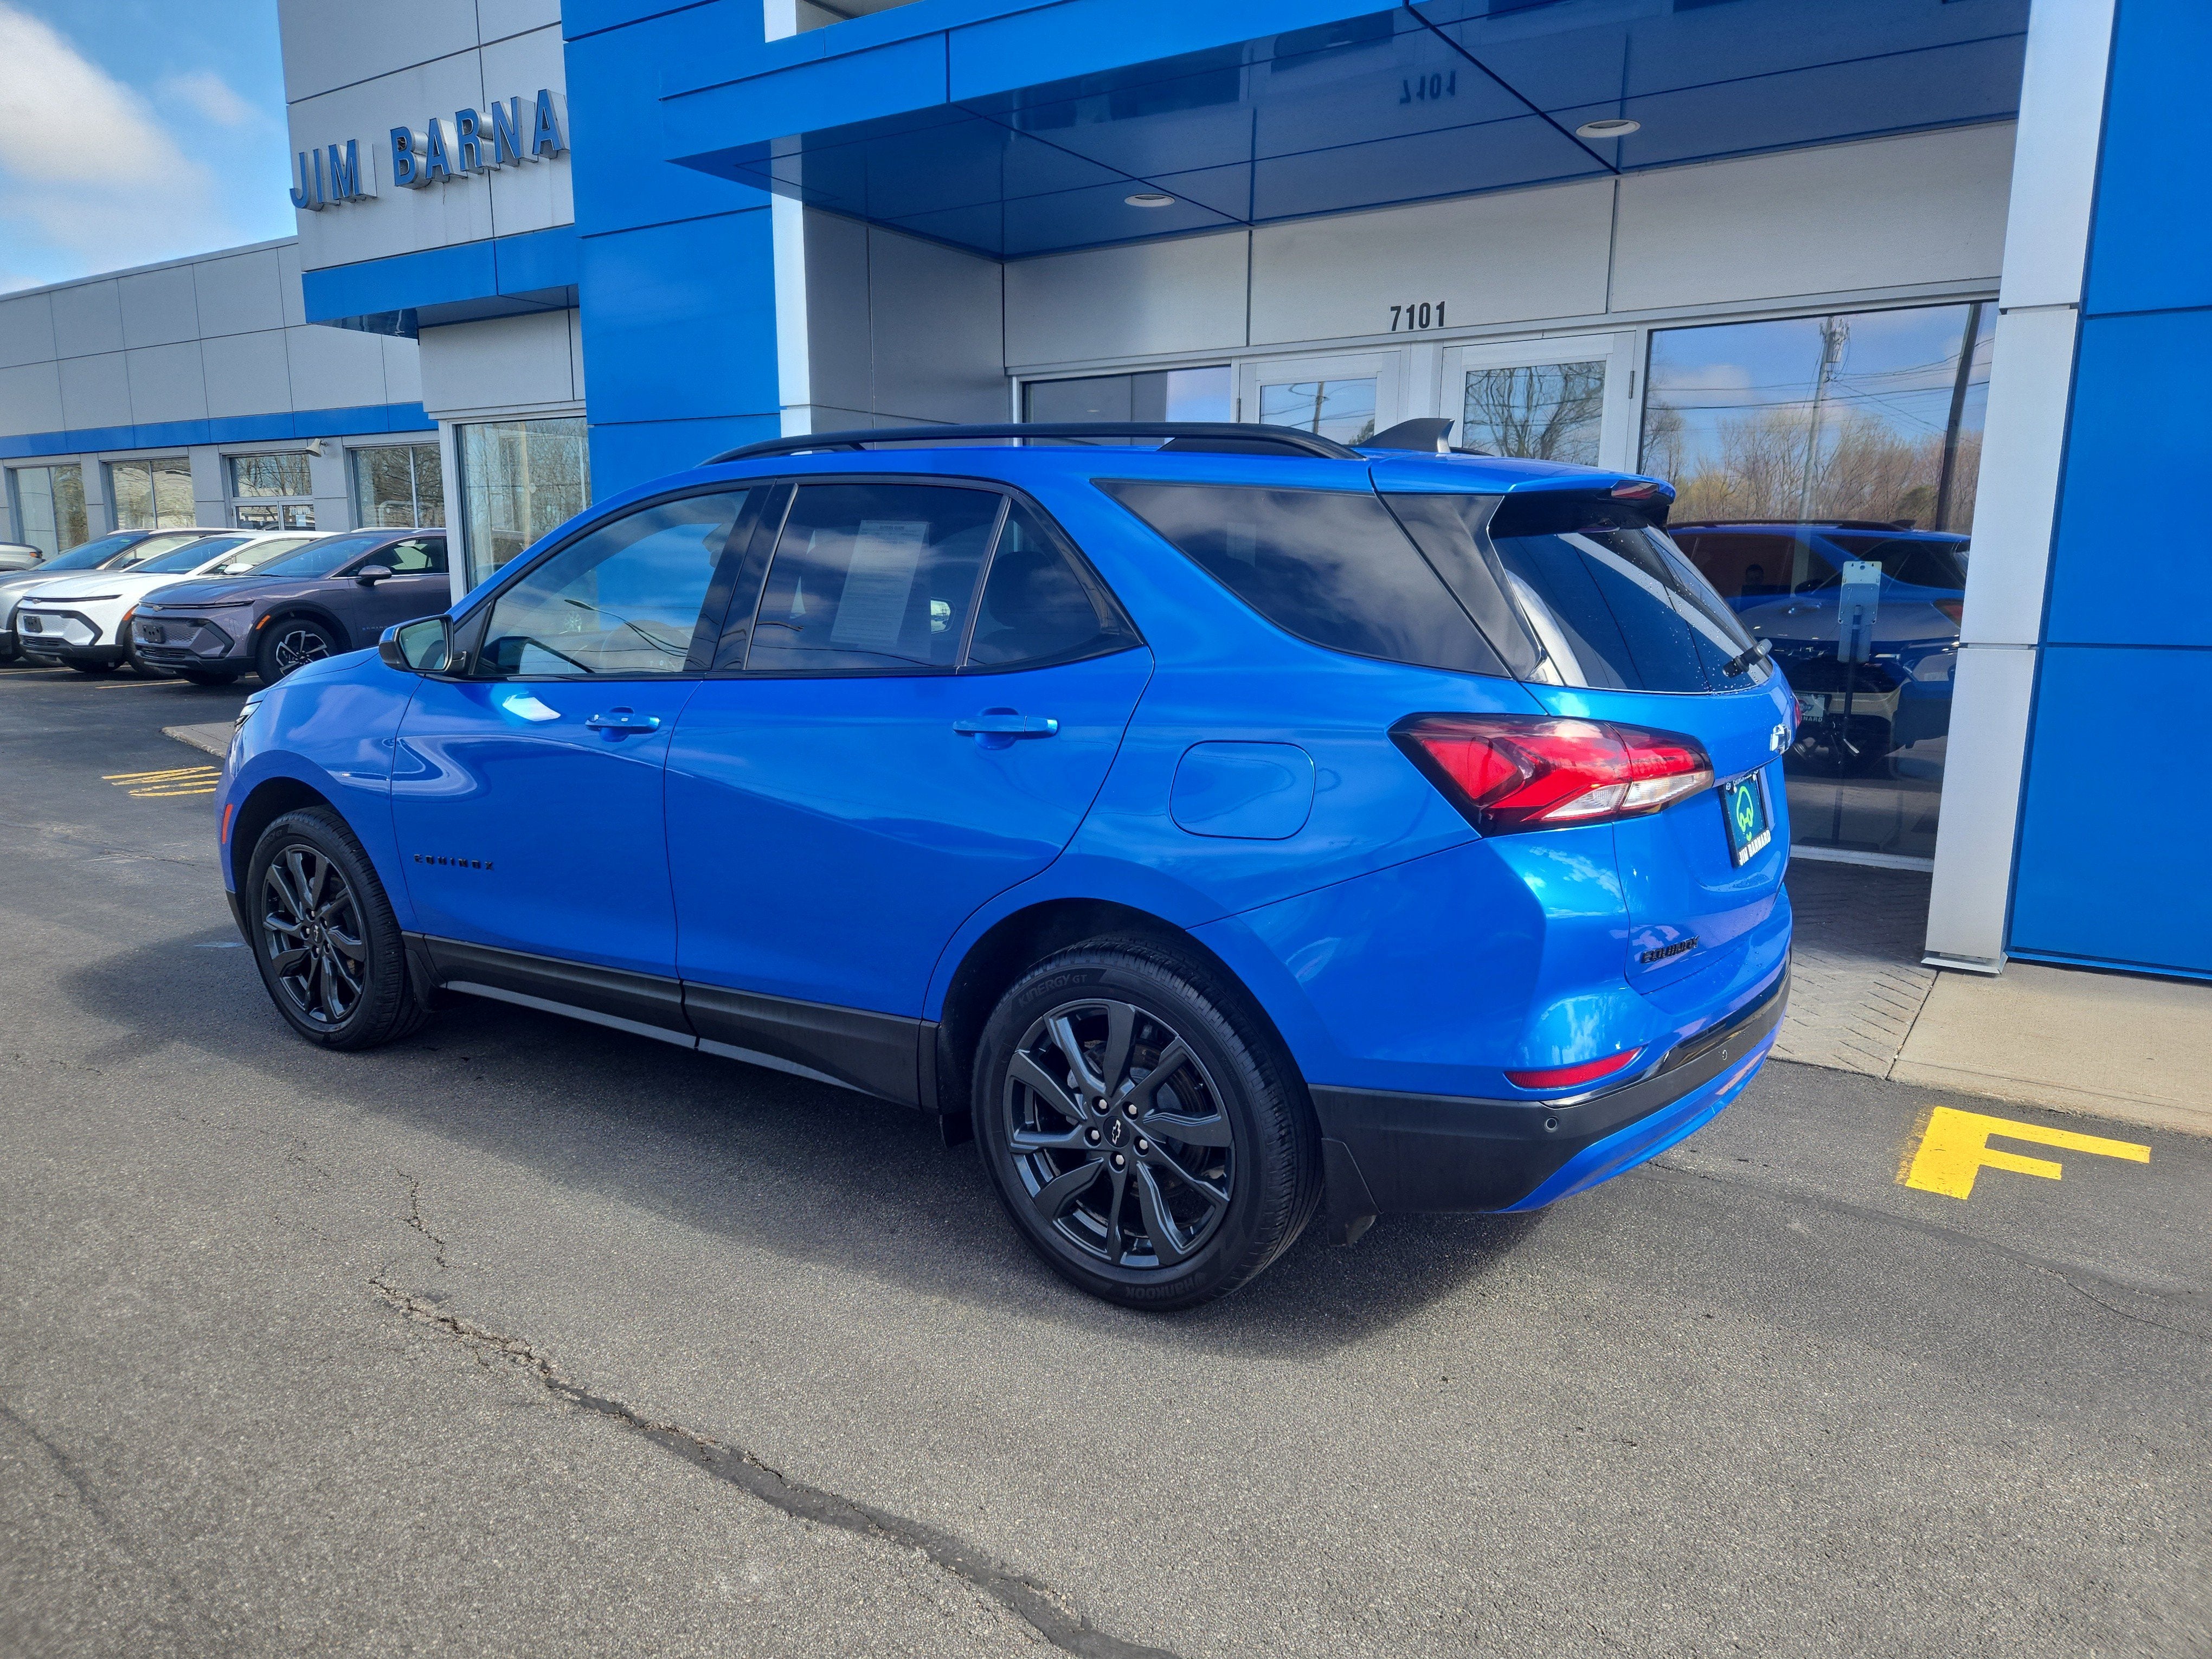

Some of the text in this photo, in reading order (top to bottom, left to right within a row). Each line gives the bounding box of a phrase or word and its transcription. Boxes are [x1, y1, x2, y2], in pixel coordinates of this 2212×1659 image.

[290, 89, 566, 210] JIM BARNA
[1390, 301, 1445, 331] 7101
[414, 854, 494, 870] EQUINOX
[1739, 829, 1771, 866] JIM BARNARD
[1641, 935, 1700, 963] EQUINOX
[1904, 1106, 2152, 1200] F
